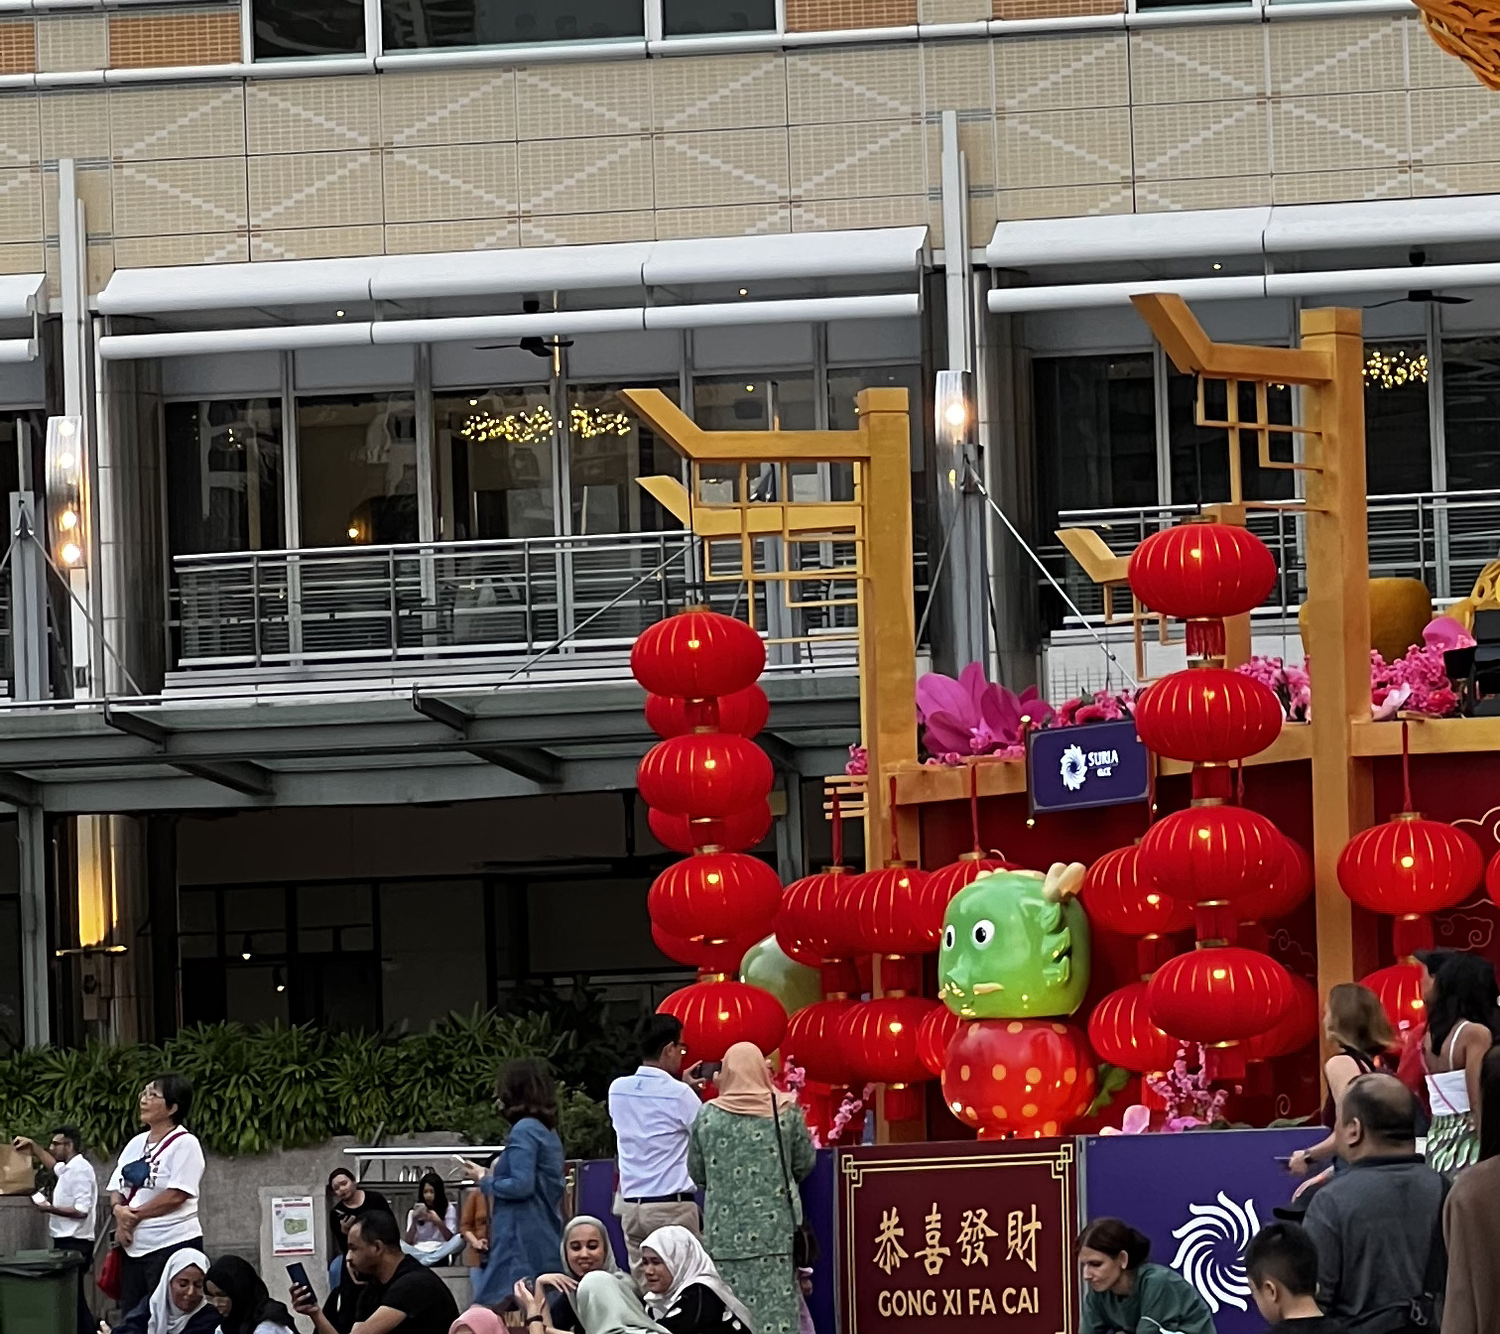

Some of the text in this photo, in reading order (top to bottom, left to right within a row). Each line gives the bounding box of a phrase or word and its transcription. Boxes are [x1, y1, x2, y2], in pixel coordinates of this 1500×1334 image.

[872, 1202, 1042, 1276] 恭喜發財
[877, 1286, 1039, 1317] GONG XI FA CAI
